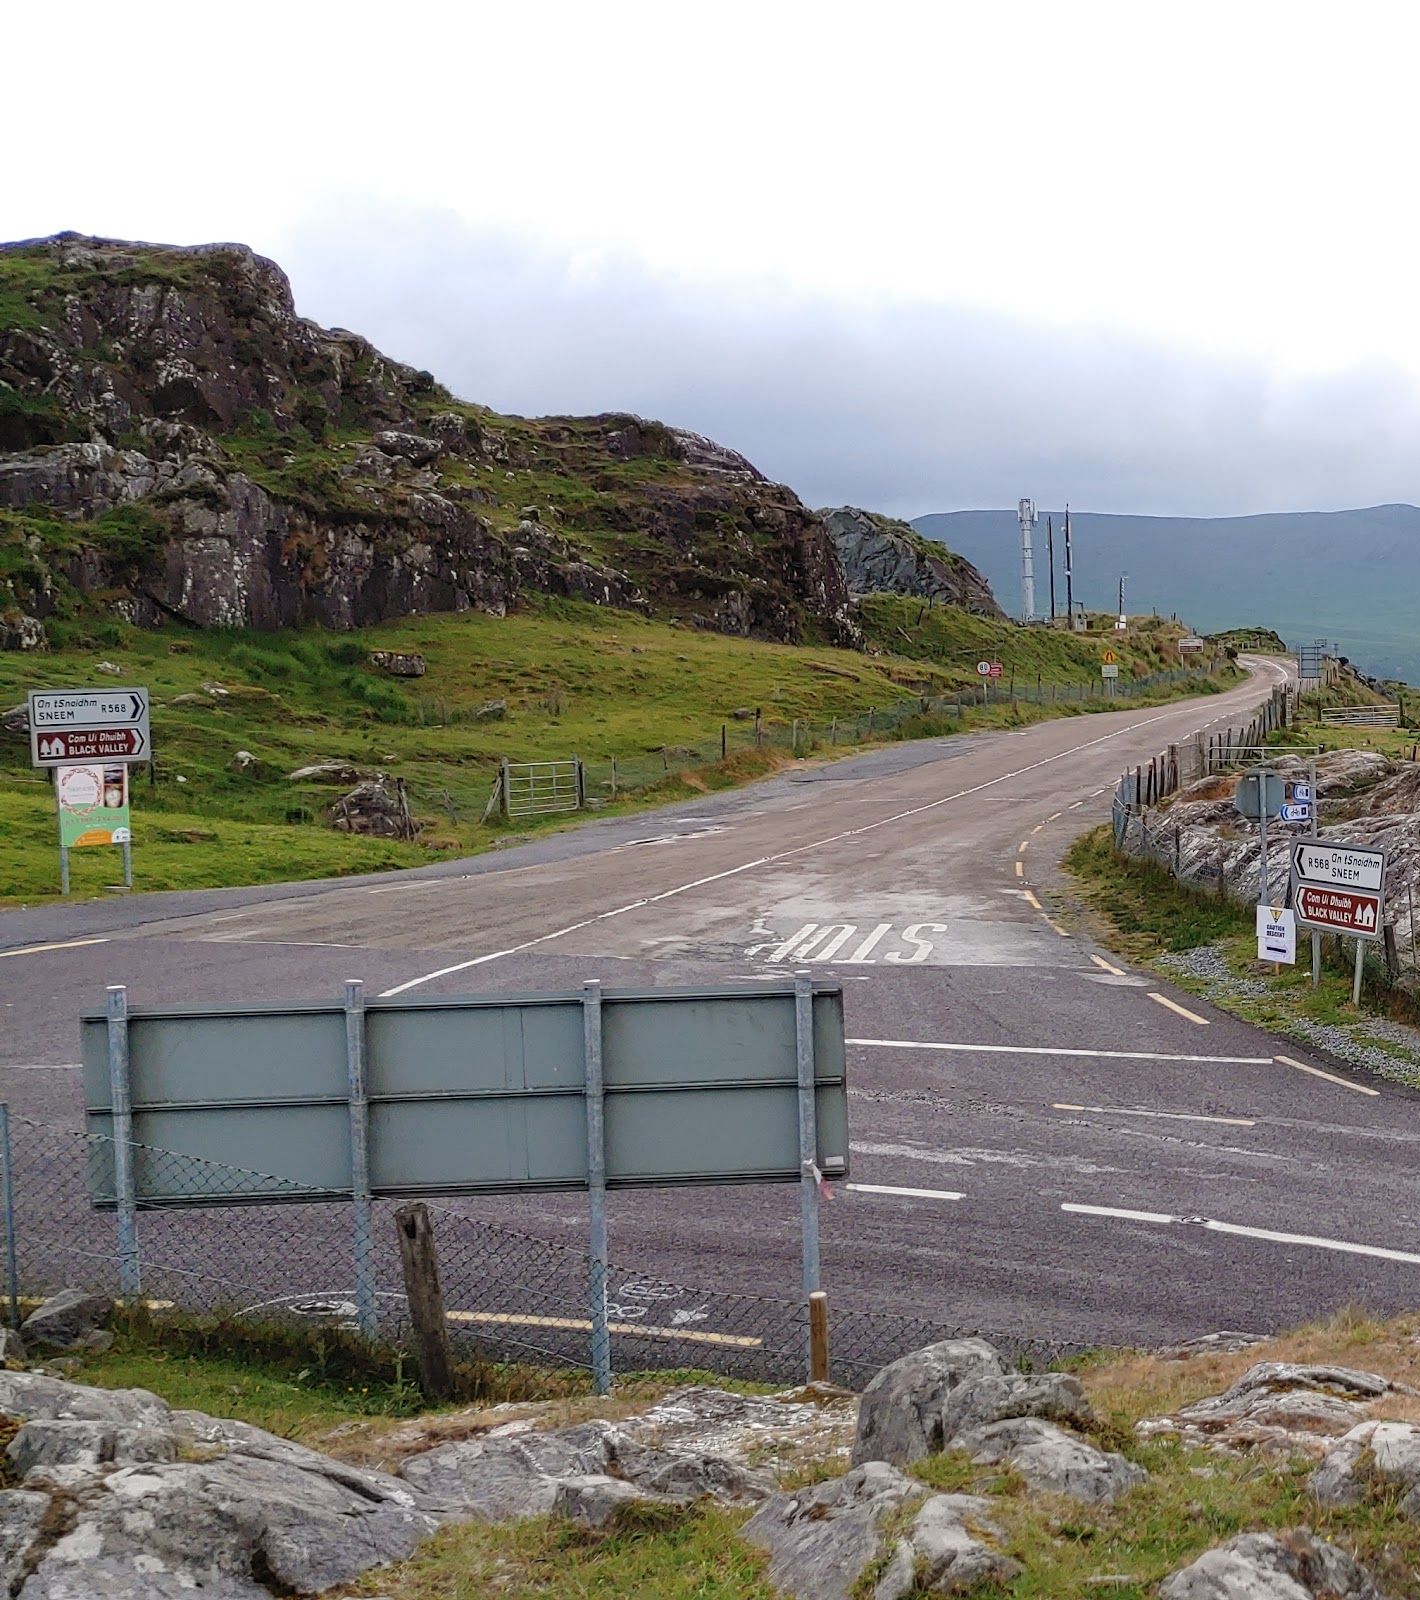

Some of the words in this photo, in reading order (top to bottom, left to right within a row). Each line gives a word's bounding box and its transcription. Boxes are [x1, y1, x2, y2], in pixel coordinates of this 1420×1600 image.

[54, 698, 98, 708] tSnaidhm
[38, 711, 75, 721] SNEEM
[67, 734, 86, 743] Com
[99, 732, 126, 742] Dhuibh
[68, 745, 97, 756] BLACK
[98, 743, 129, 753] VALLEY
[1344, 854, 1380, 869] tSnaidhm
[1331, 867, 1360, 881] SNEEM
[1306, 891, 1321, 903] Com
[1329, 895, 1352, 910] Dhuibh
[1307, 905, 1328, 919] BLACK
[1328, 909, 1353, 924] VALLEY
